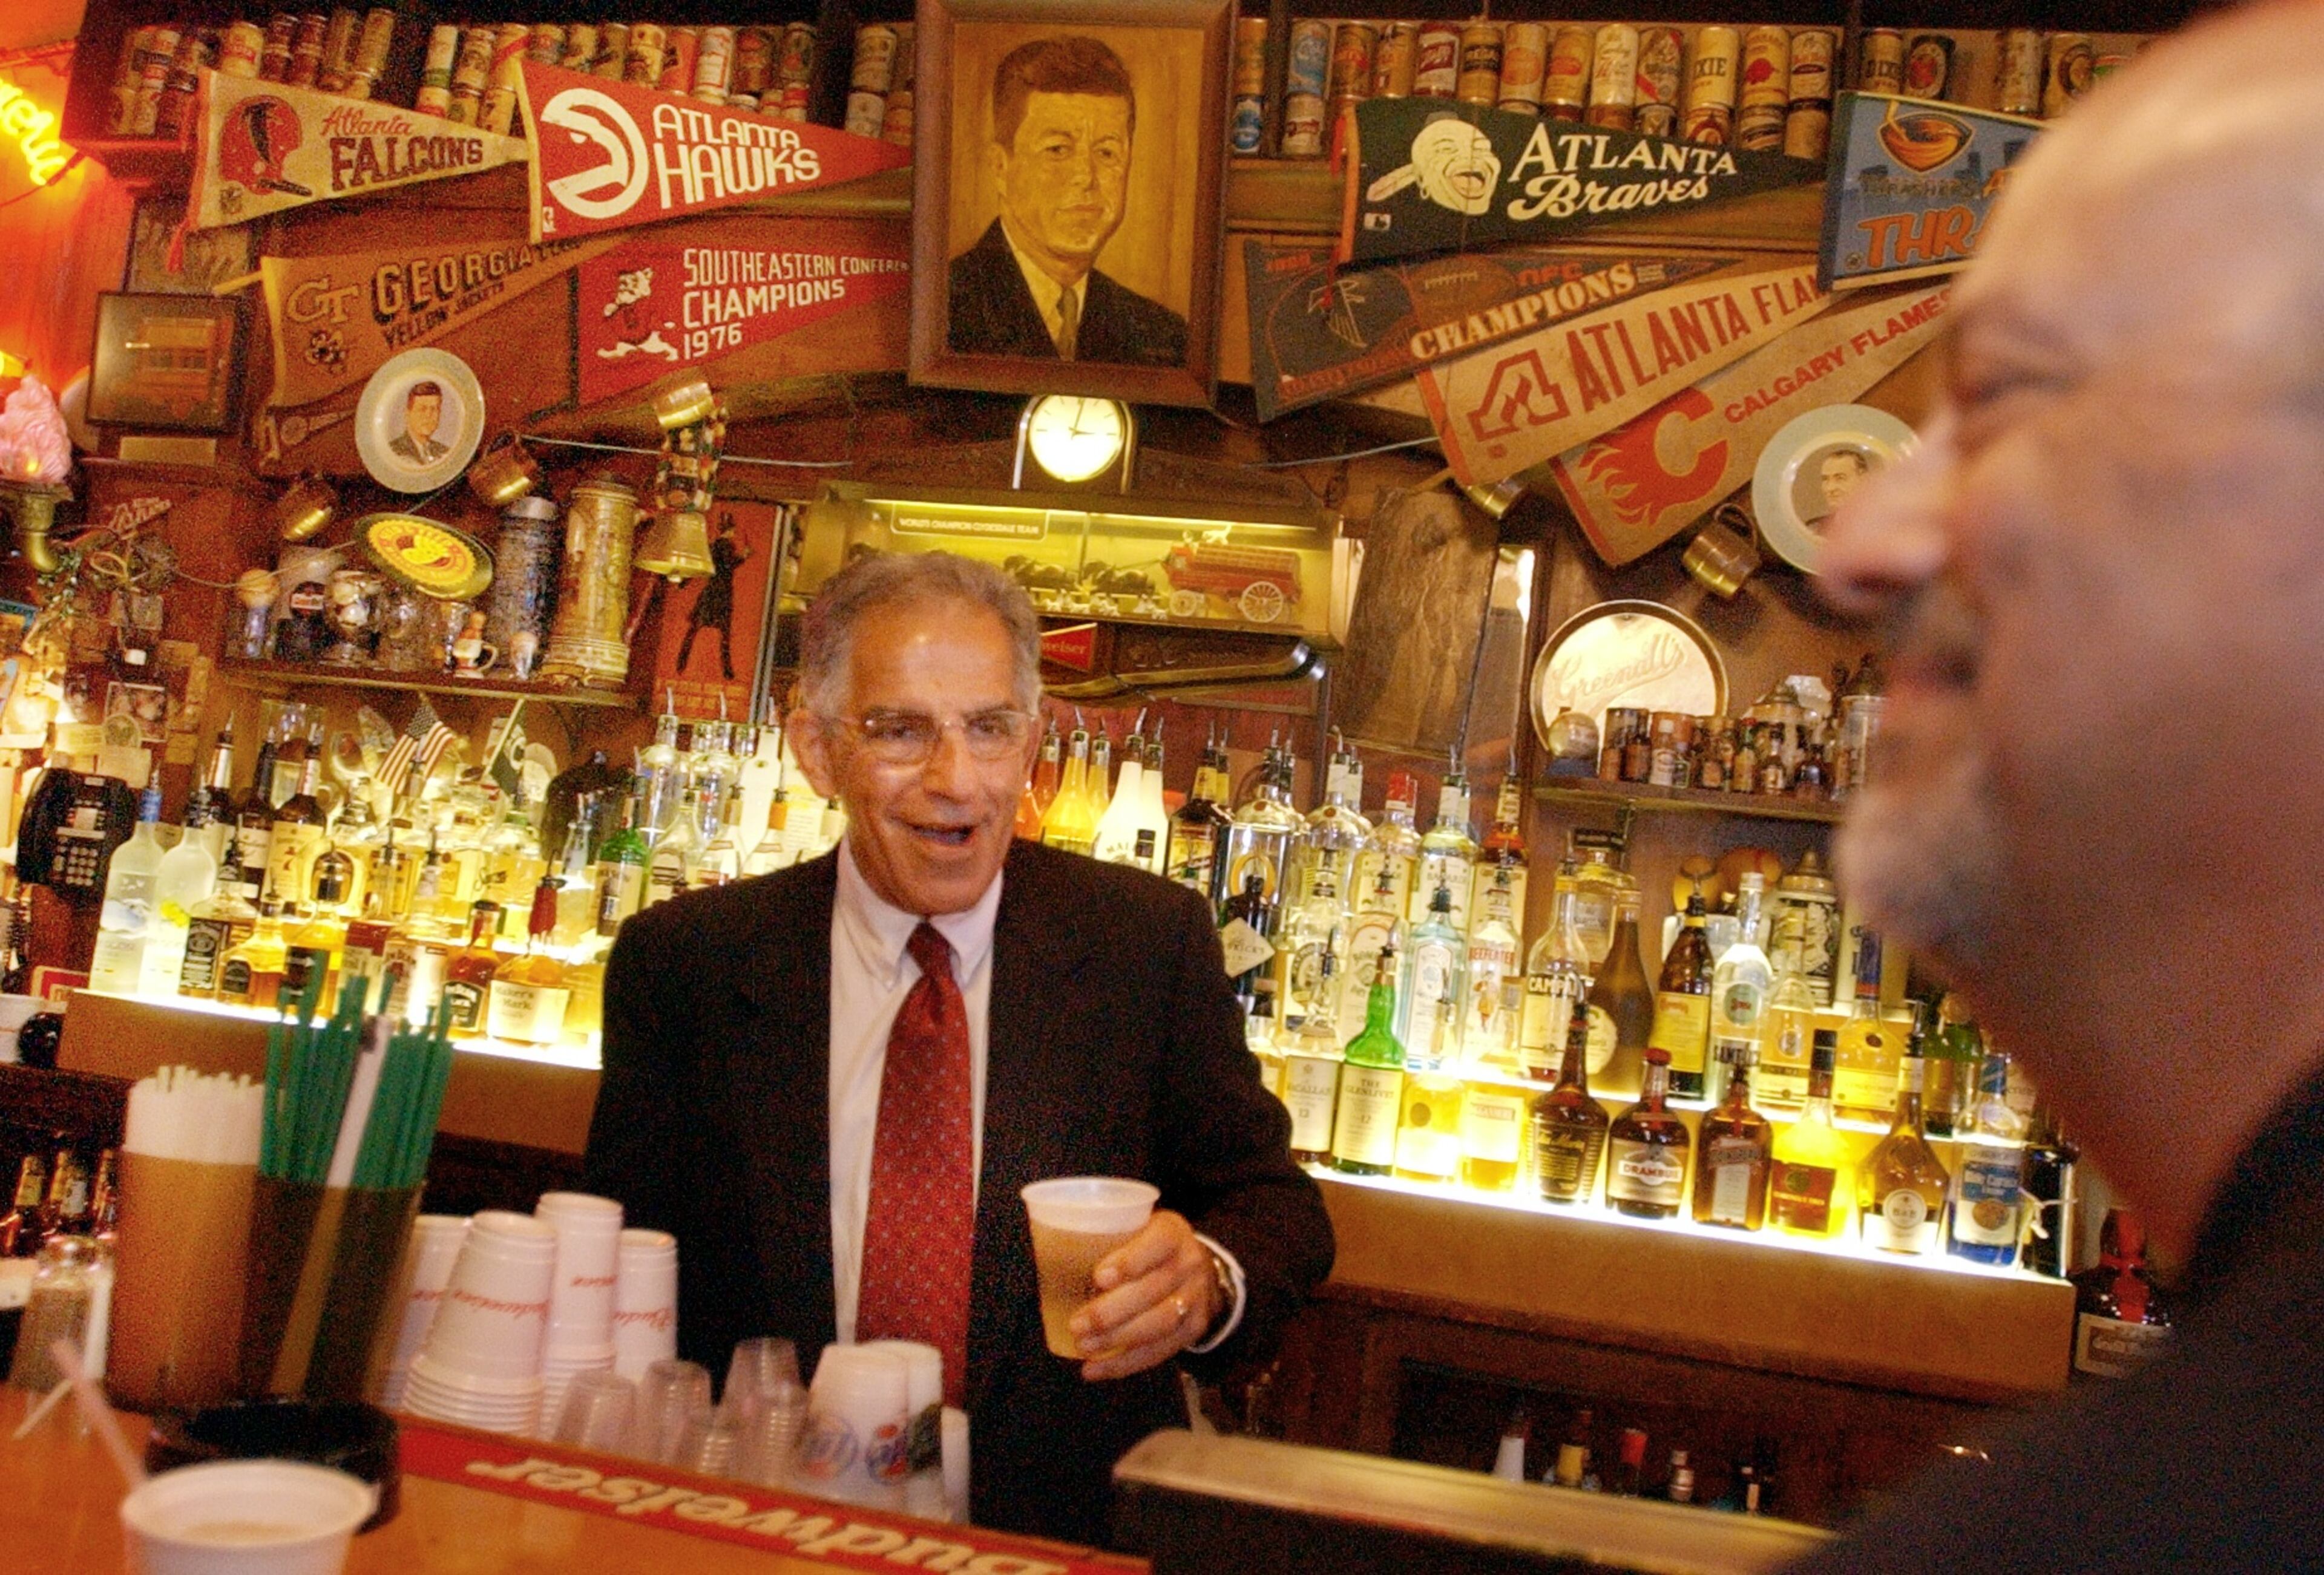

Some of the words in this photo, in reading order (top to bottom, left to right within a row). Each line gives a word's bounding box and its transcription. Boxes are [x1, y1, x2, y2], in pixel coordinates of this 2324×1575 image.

[320, 105, 414, 137] Atlanta
[652, 103, 800, 149] ATLANTA
[330, 136, 483, 191] FALCONS
[652, 142, 821, 209] HAWKS
[1507, 122, 1738, 183] ATLANTA
[1507, 173, 1709, 221] Braves
[1857, 205, 1977, 269] THR
[371, 244, 533, 326] GEORGIA
[683, 248, 835, 287] SOUTHEASTERN
[683, 278, 845, 329] CHAMPIONS
[1410, 262, 1636, 359] CHAMPIONS
[684, 323, 743, 360] 1976
[1565, 292, 1751, 413] ATLANTA
[1724, 345, 1847, 424] CALGARY
